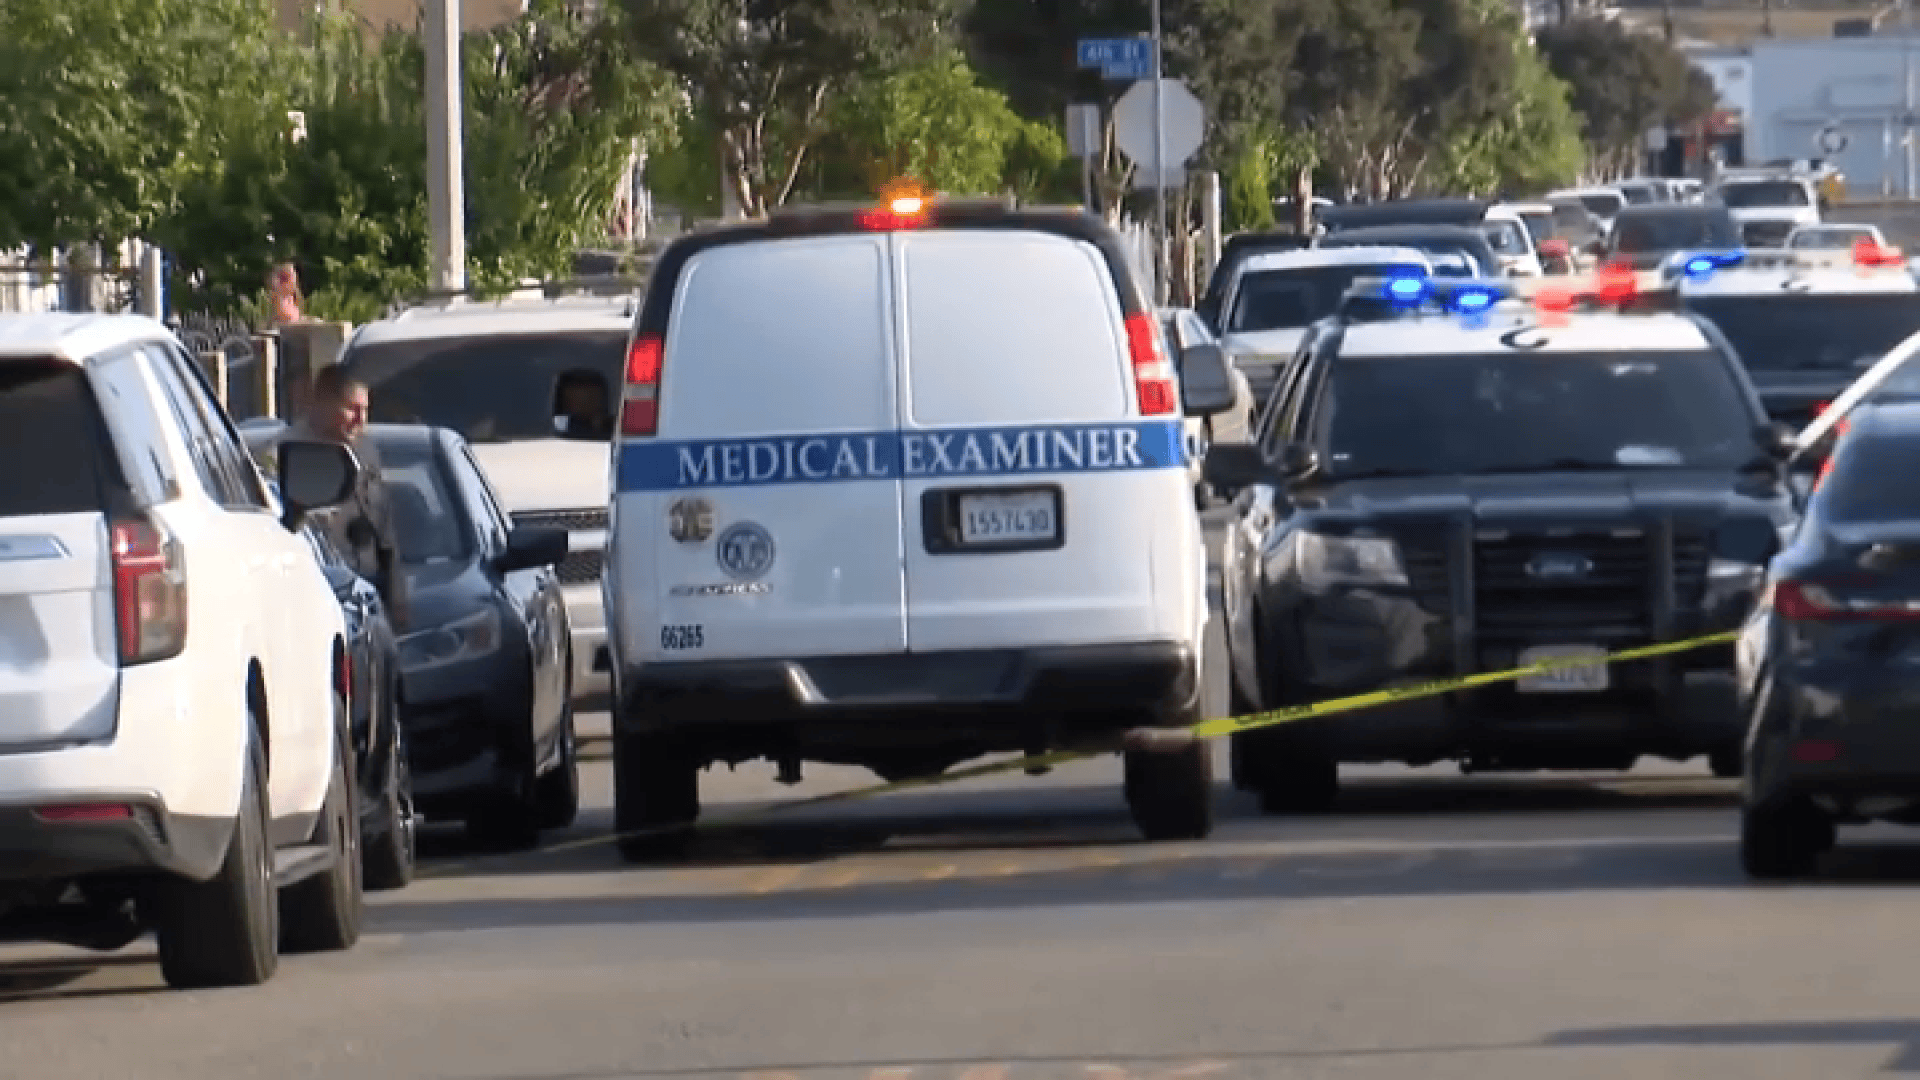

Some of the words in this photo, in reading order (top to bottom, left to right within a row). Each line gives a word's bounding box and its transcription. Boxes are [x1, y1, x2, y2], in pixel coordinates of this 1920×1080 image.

[678, 436, 889, 484] MEDICAL
[903, 429, 1142, 473] EXAMINER
[661, 625, 704, 650] 66265
